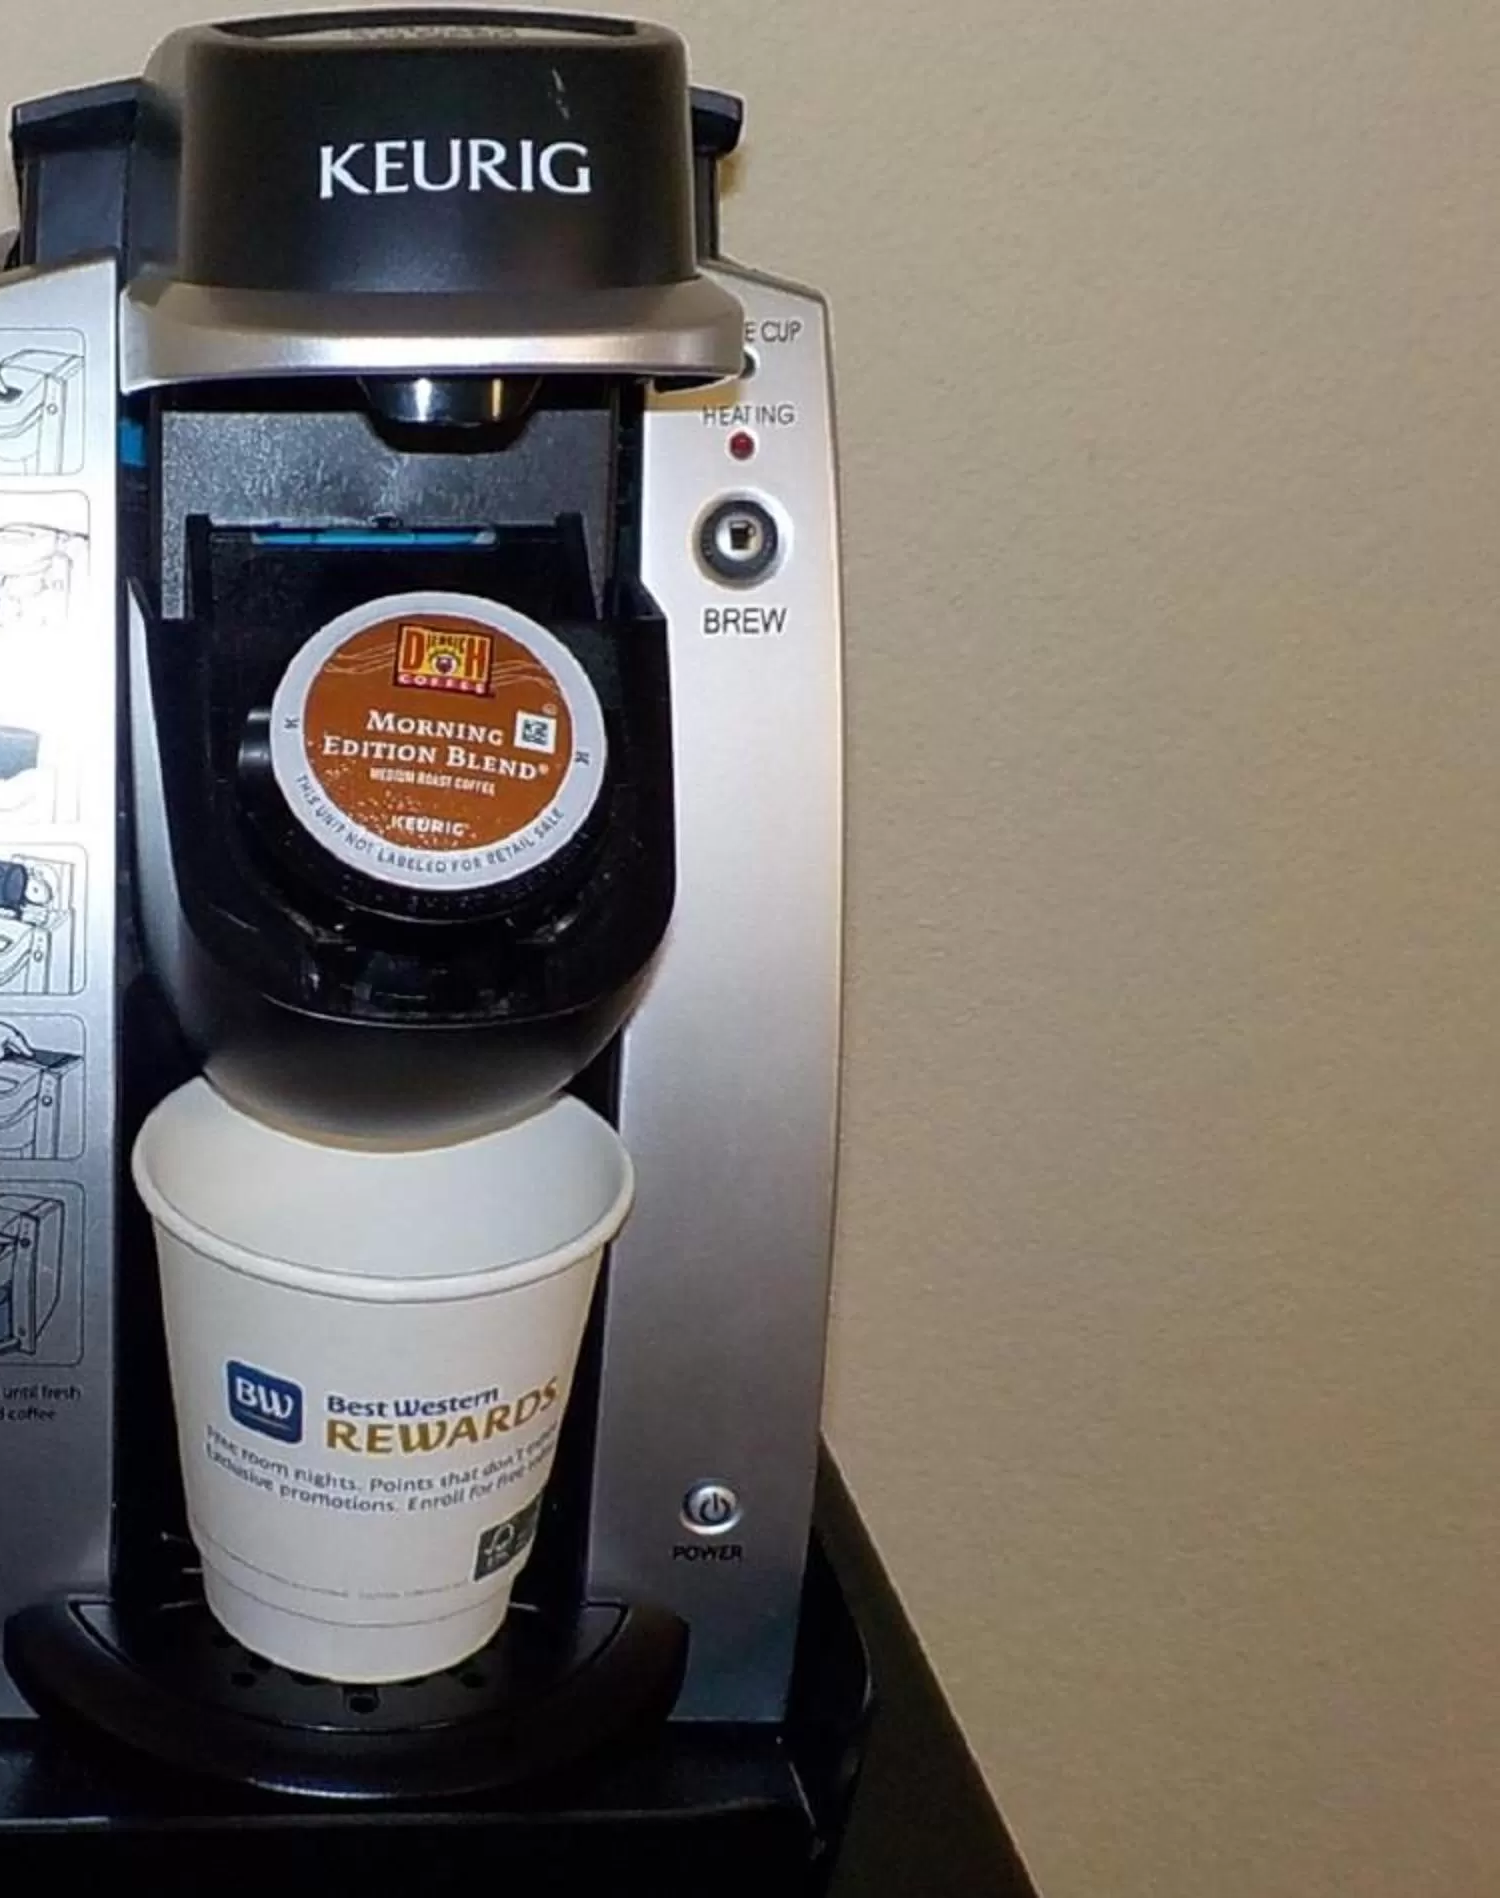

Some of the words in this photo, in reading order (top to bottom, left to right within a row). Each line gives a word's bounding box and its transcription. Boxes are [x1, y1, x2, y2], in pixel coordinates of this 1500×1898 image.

[319, 138, 592, 199] KEURIG
[762, 321, 802, 342] CUP
[703, 404, 796, 426] HEATING
[704, 608, 787, 634] BREW
[366, 709, 504, 746] MORNING
[323, 735, 437, 764] EDITION
[416, 773, 453, 789] ROAST
[295, 775, 322, 806] THIS
[315, 806, 345, 834] UNIT
[346, 831, 375, 855] NOT
[377, 848, 447, 873] LABELED
[451, 856, 482, 872] FOR
[487, 838, 535, 866] RETAIL
[534, 806, 565, 839] SALE
[390, 815, 465, 838] KEURIG
[2, 1384, 37, 1399] until
[40, 1383, 81, 1400] fresh
[234, 1376, 294, 1421] BW
[326, 1394, 389, 1418] Best
[392, 1386, 500, 1418] Western
[7, 1406, 56, 1422] coffee
[326, 1375, 558, 1455] REWARDS
[241, 1448, 290, 1480] room
[370, 1476, 434, 1493] Points
[440, 1467, 479, 1488] that
[408, 1488, 465, 1511] Enroll
[672, 1545, 743, 1562] POWER
